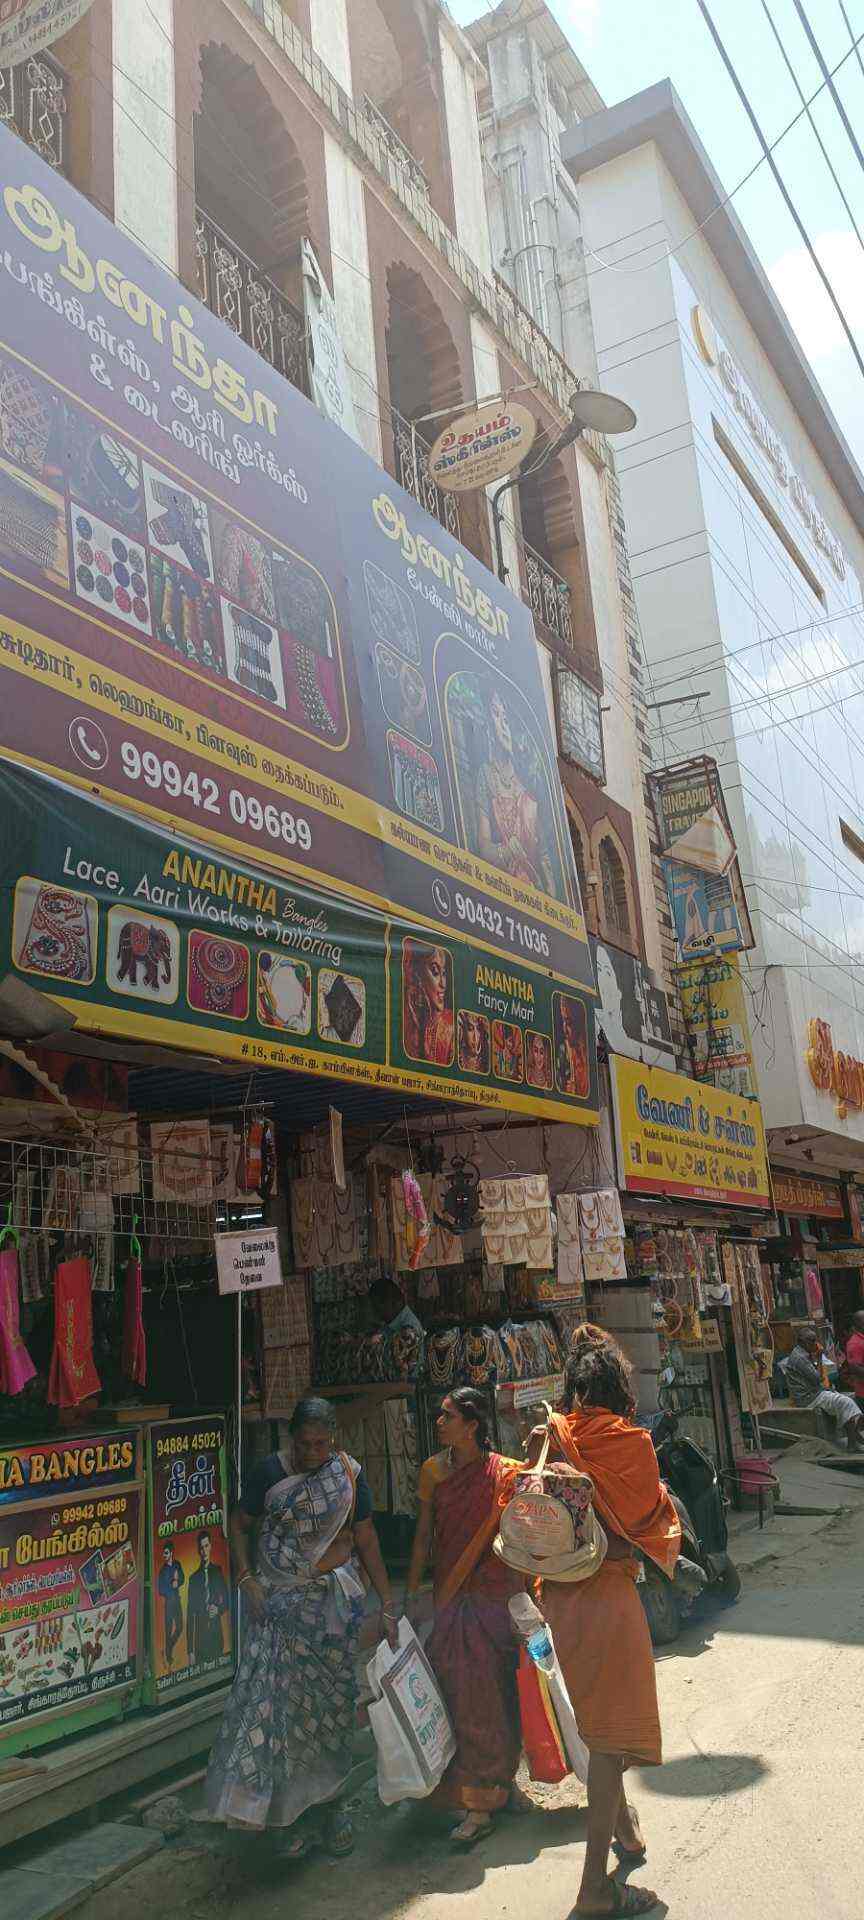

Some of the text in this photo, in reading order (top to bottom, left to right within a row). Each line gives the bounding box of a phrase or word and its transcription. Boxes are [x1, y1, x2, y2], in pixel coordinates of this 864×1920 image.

[3, 185, 279, 436] ஆனந்தா
[90, 353, 241, 485] & டைலரிங்
[171, 385, 226, 442] ஆரி
[440, 413, 512, 454] உதயம்
[372, 493, 510, 641] ஆனந்தா
[0, 630, 83, 689] சுடிதார்,
[88, 673, 192, 742] லெஹங்கா,
[119, 741, 313, 851] 99942 09689
[62, 846, 344, 966] Lace, Aari Works & Tailoring
[162, 850, 330, 934] ANANTHA Bangles
[455, 892, 550, 957] 90432 71036
[691, 934, 715, 949] வழி
[475, 963, 535, 1003] ANANTHA
[477, 987, 535, 1023] Fancy Mart
[251, 1044, 268, 1062] 18,
[697, 1104, 710, 1136] &
[29, 1441, 134, 1484] BANGLES
[156, 1430, 222, 1457] 94884 45021
[62, 1497, 127, 1522] 99942 09689
[166, 1454, 216, 1514] தீன்
